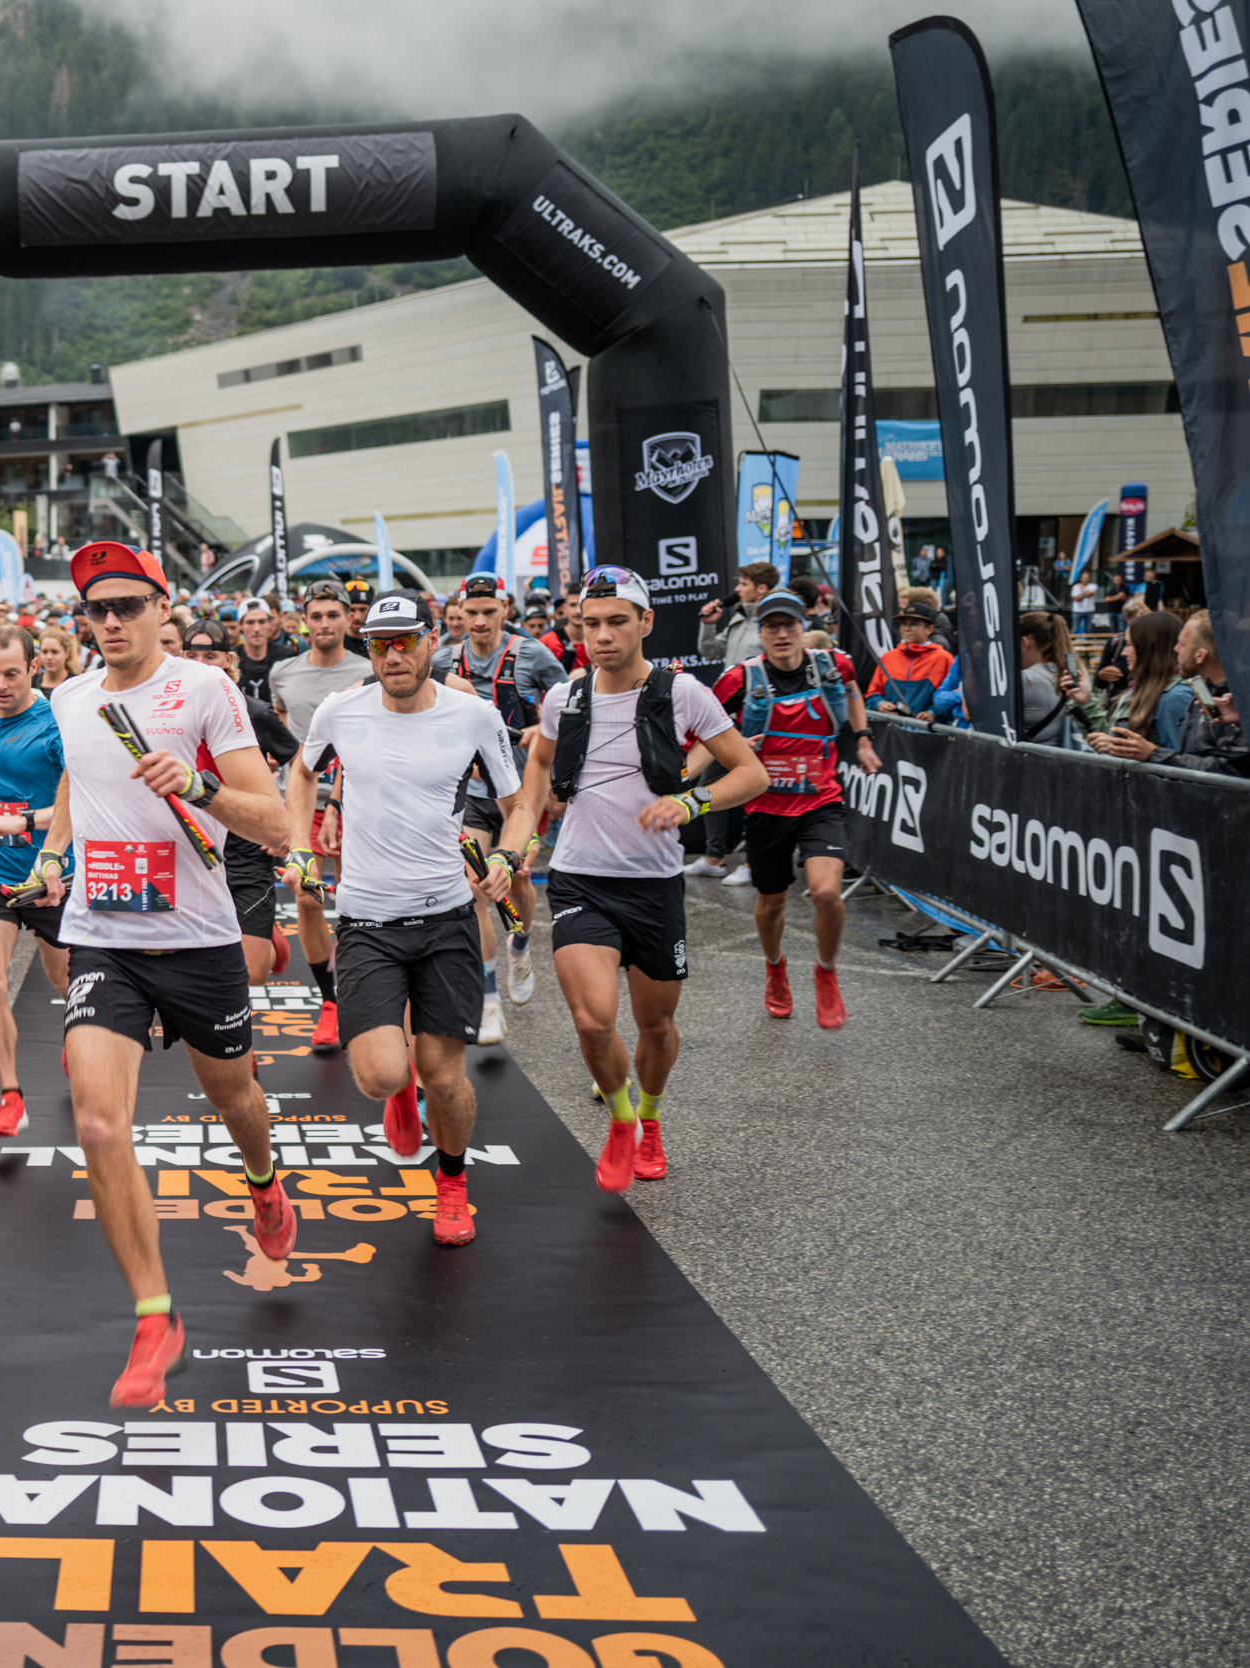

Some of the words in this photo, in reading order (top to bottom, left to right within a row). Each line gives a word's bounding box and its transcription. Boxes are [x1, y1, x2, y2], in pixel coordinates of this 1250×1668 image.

[112, 154, 340, 221] START
[532, 194, 642, 290] ULTRAKS.COM
[652, 596, 675, 605] TIME
[678, 595, 690, 603] TO
[692, 592, 710, 602] PLAY
[152, 692, 187, 700] salomon
[218, 677, 244, 734] salomon
[145, 727, 184, 736] SUUNTO
[837, 760, 894, 822] omon
[969, 803, 1141, 918] salomon
[87, 881, 132, 902] 3213
[214, 1019, 243, 1031] Running
[160, 1115, 191, 1123] BY
[132, 1124, 428, 1144] SERIE
[71, 1169, 469, 1197] TRAI
[193, 1348, 387, 1359] salomon
[148, 1399, 195, 1413] BY
[210, 1399, 449, 1415] SUPPORTED
[21, 1420, 592, 1470] SERIES
